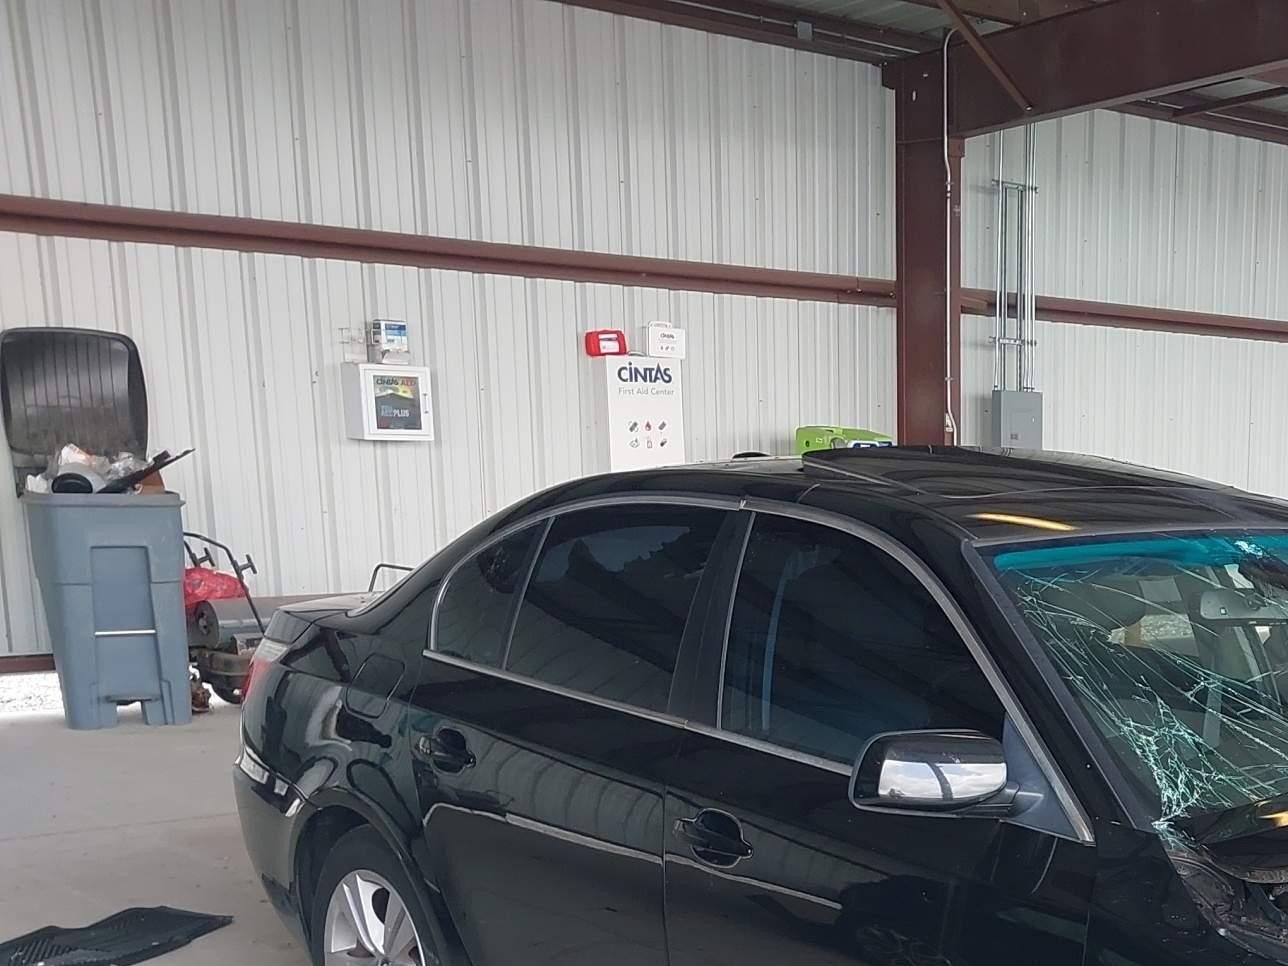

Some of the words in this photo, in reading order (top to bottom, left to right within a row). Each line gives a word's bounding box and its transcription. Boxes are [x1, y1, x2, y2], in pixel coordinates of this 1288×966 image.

[617, 361, 673, 384] CINTAS
[618, 386, 635, 396] First
[636, 386, 649, 396] Aid
[650, 386, 675, 397] Center
